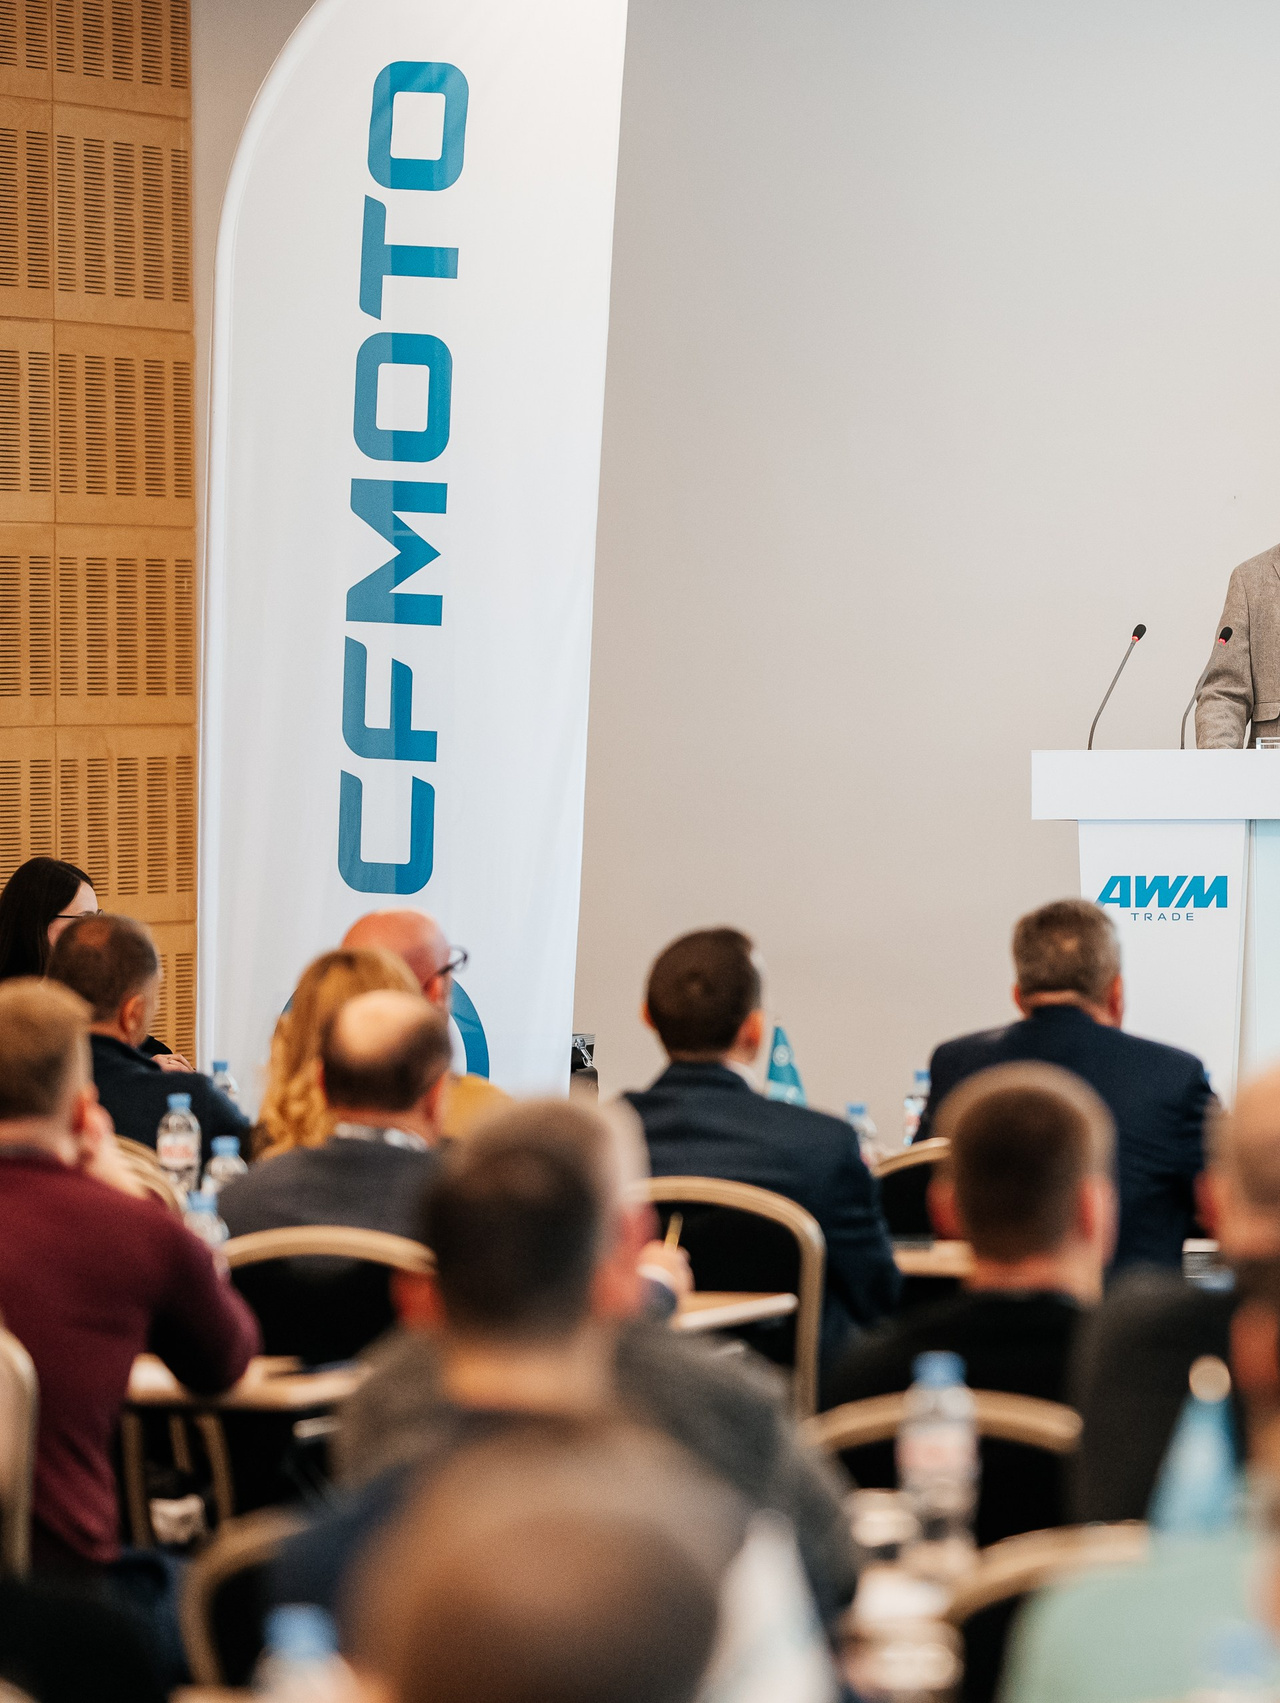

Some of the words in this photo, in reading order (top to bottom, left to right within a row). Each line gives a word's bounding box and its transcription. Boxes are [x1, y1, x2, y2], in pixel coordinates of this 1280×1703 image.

[338, 60, 470, 895] CFMOTO
[1096, 875, 1228, 908] AWM
[1131, 912, 1194, 921] TRADE
